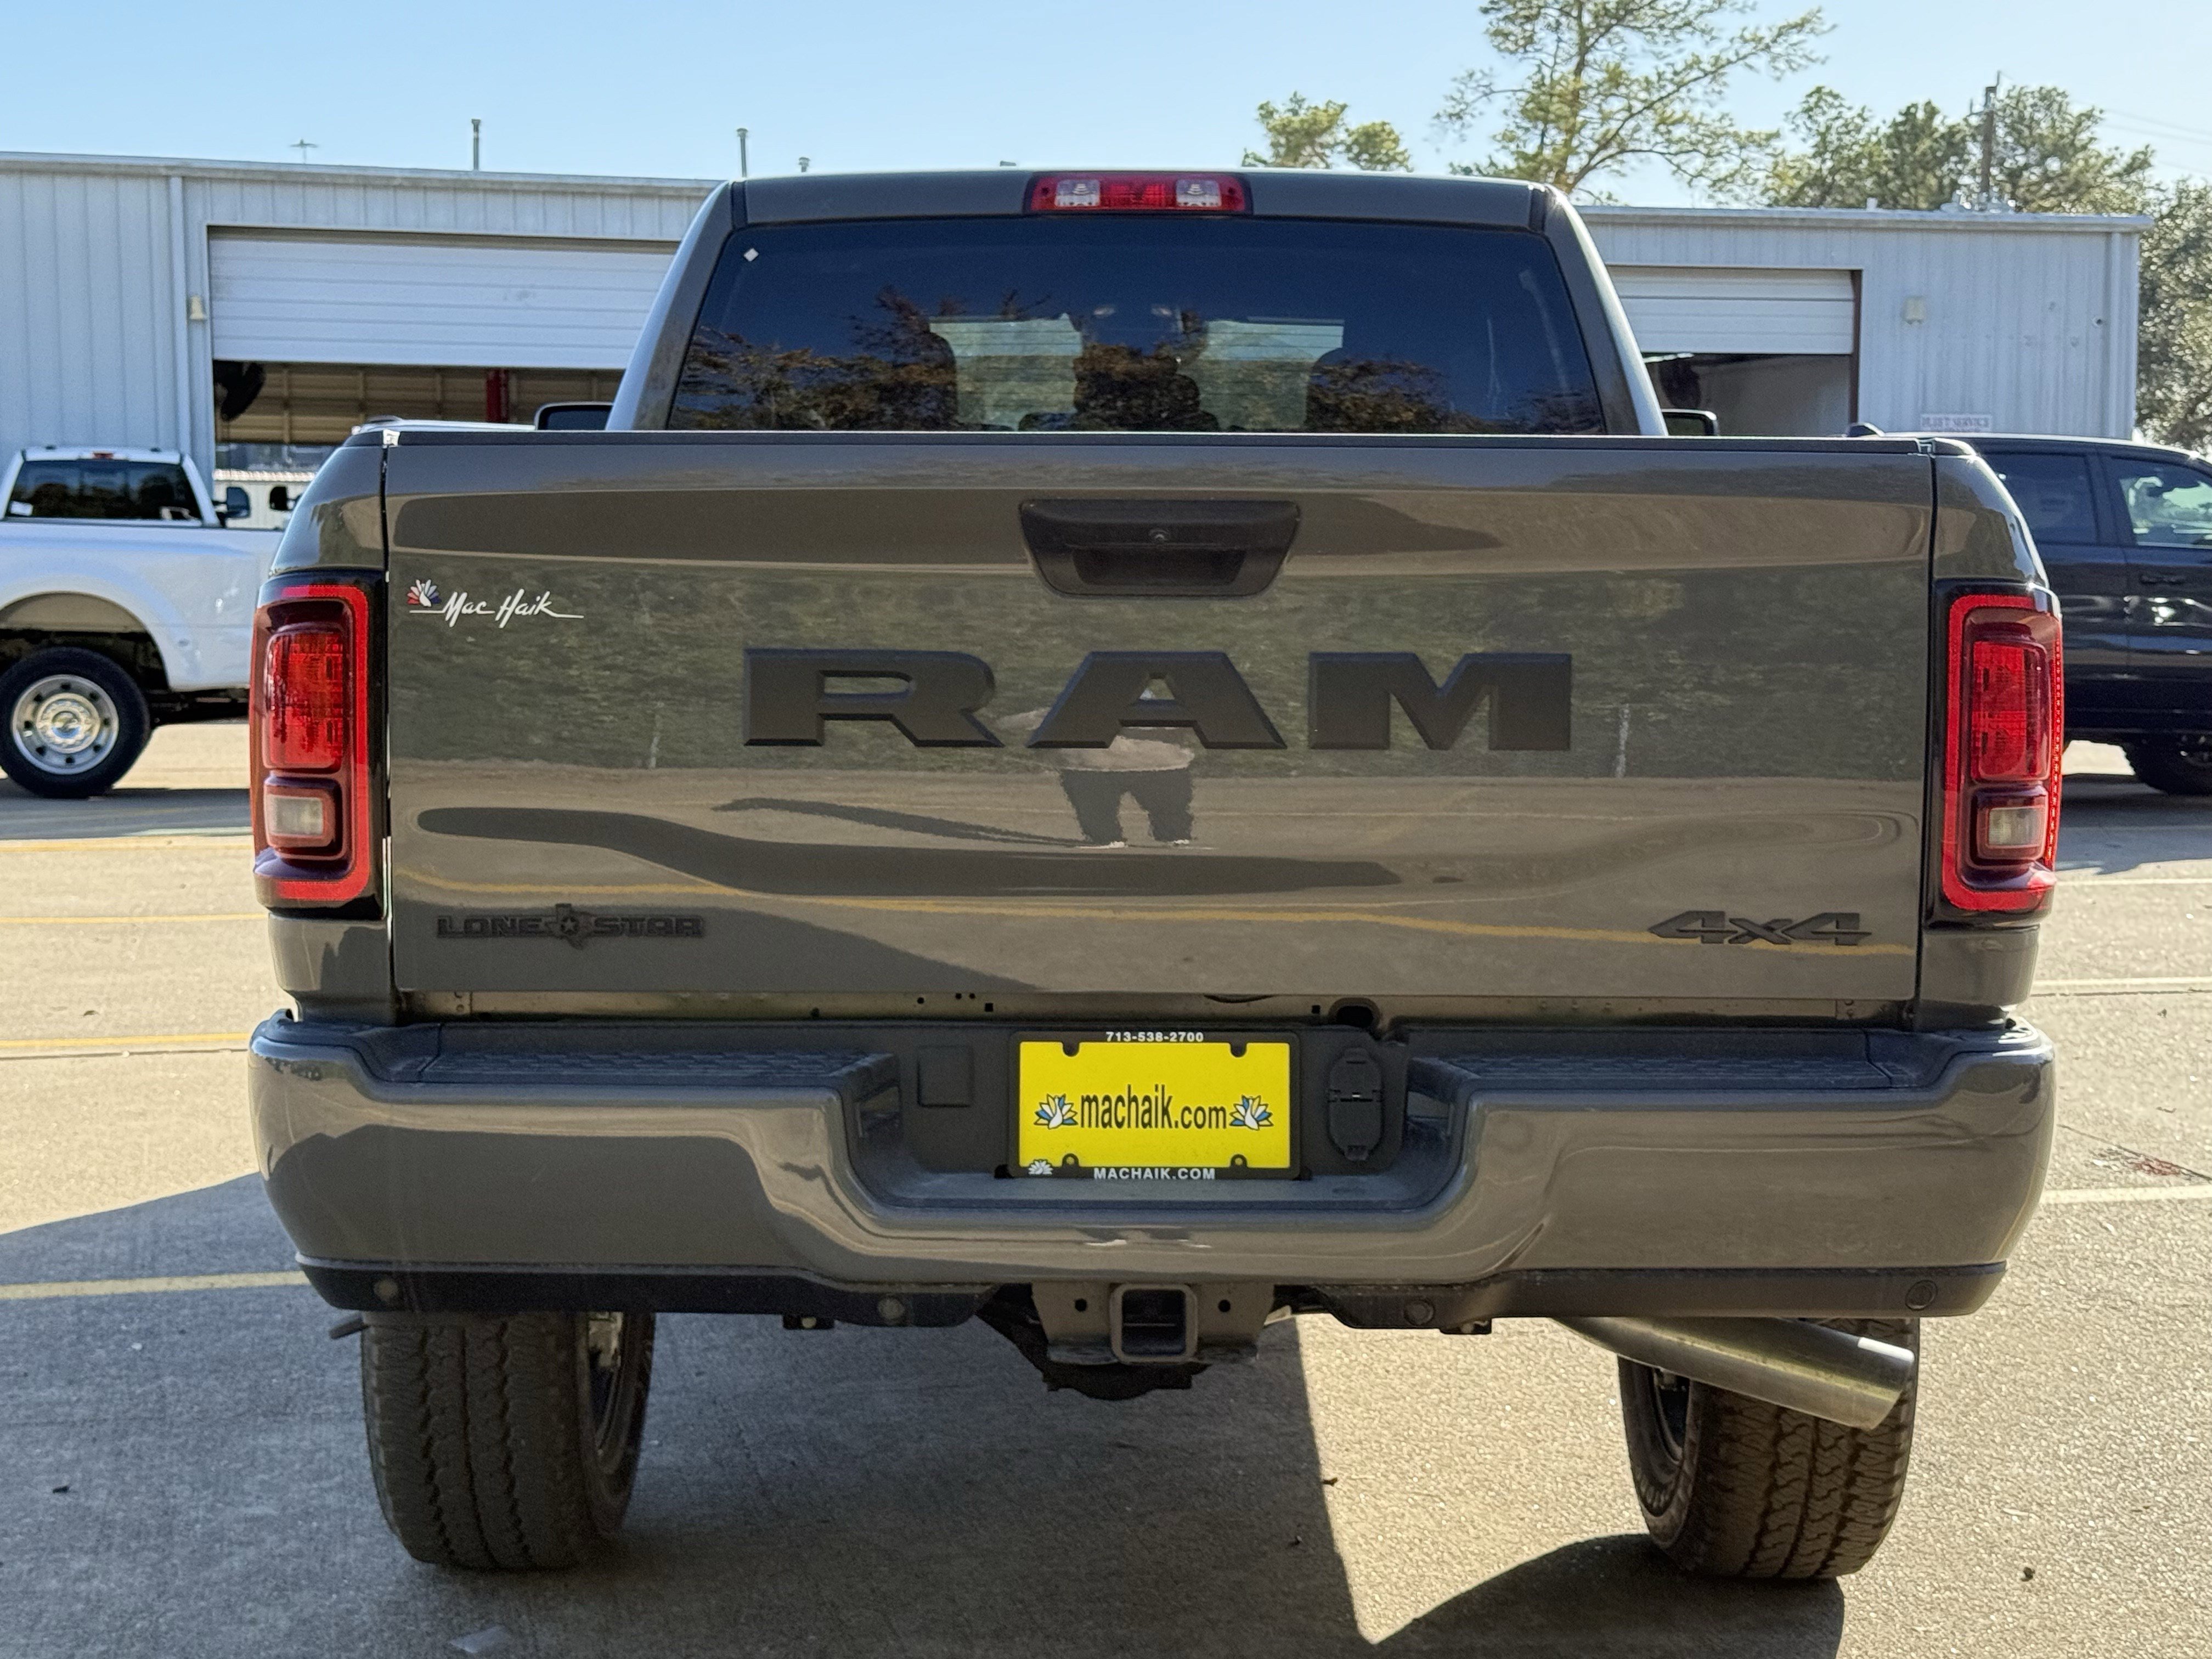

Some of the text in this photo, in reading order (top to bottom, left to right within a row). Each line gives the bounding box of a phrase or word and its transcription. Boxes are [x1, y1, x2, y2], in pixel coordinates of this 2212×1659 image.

[410, 589, 584, 628] Mac Haik
[744, 649, 1572, 751] RAM
[438, 916, 704, 938] LONE STAR
[1648, 911, 1872, 945] 4x4
[1105, 1032, 1204, 1042] 713-538-2700
[1081, 1084, 1227, 1128] machaik.com
[1094, 1168, 1216, 1180] MACHAIK.COM
